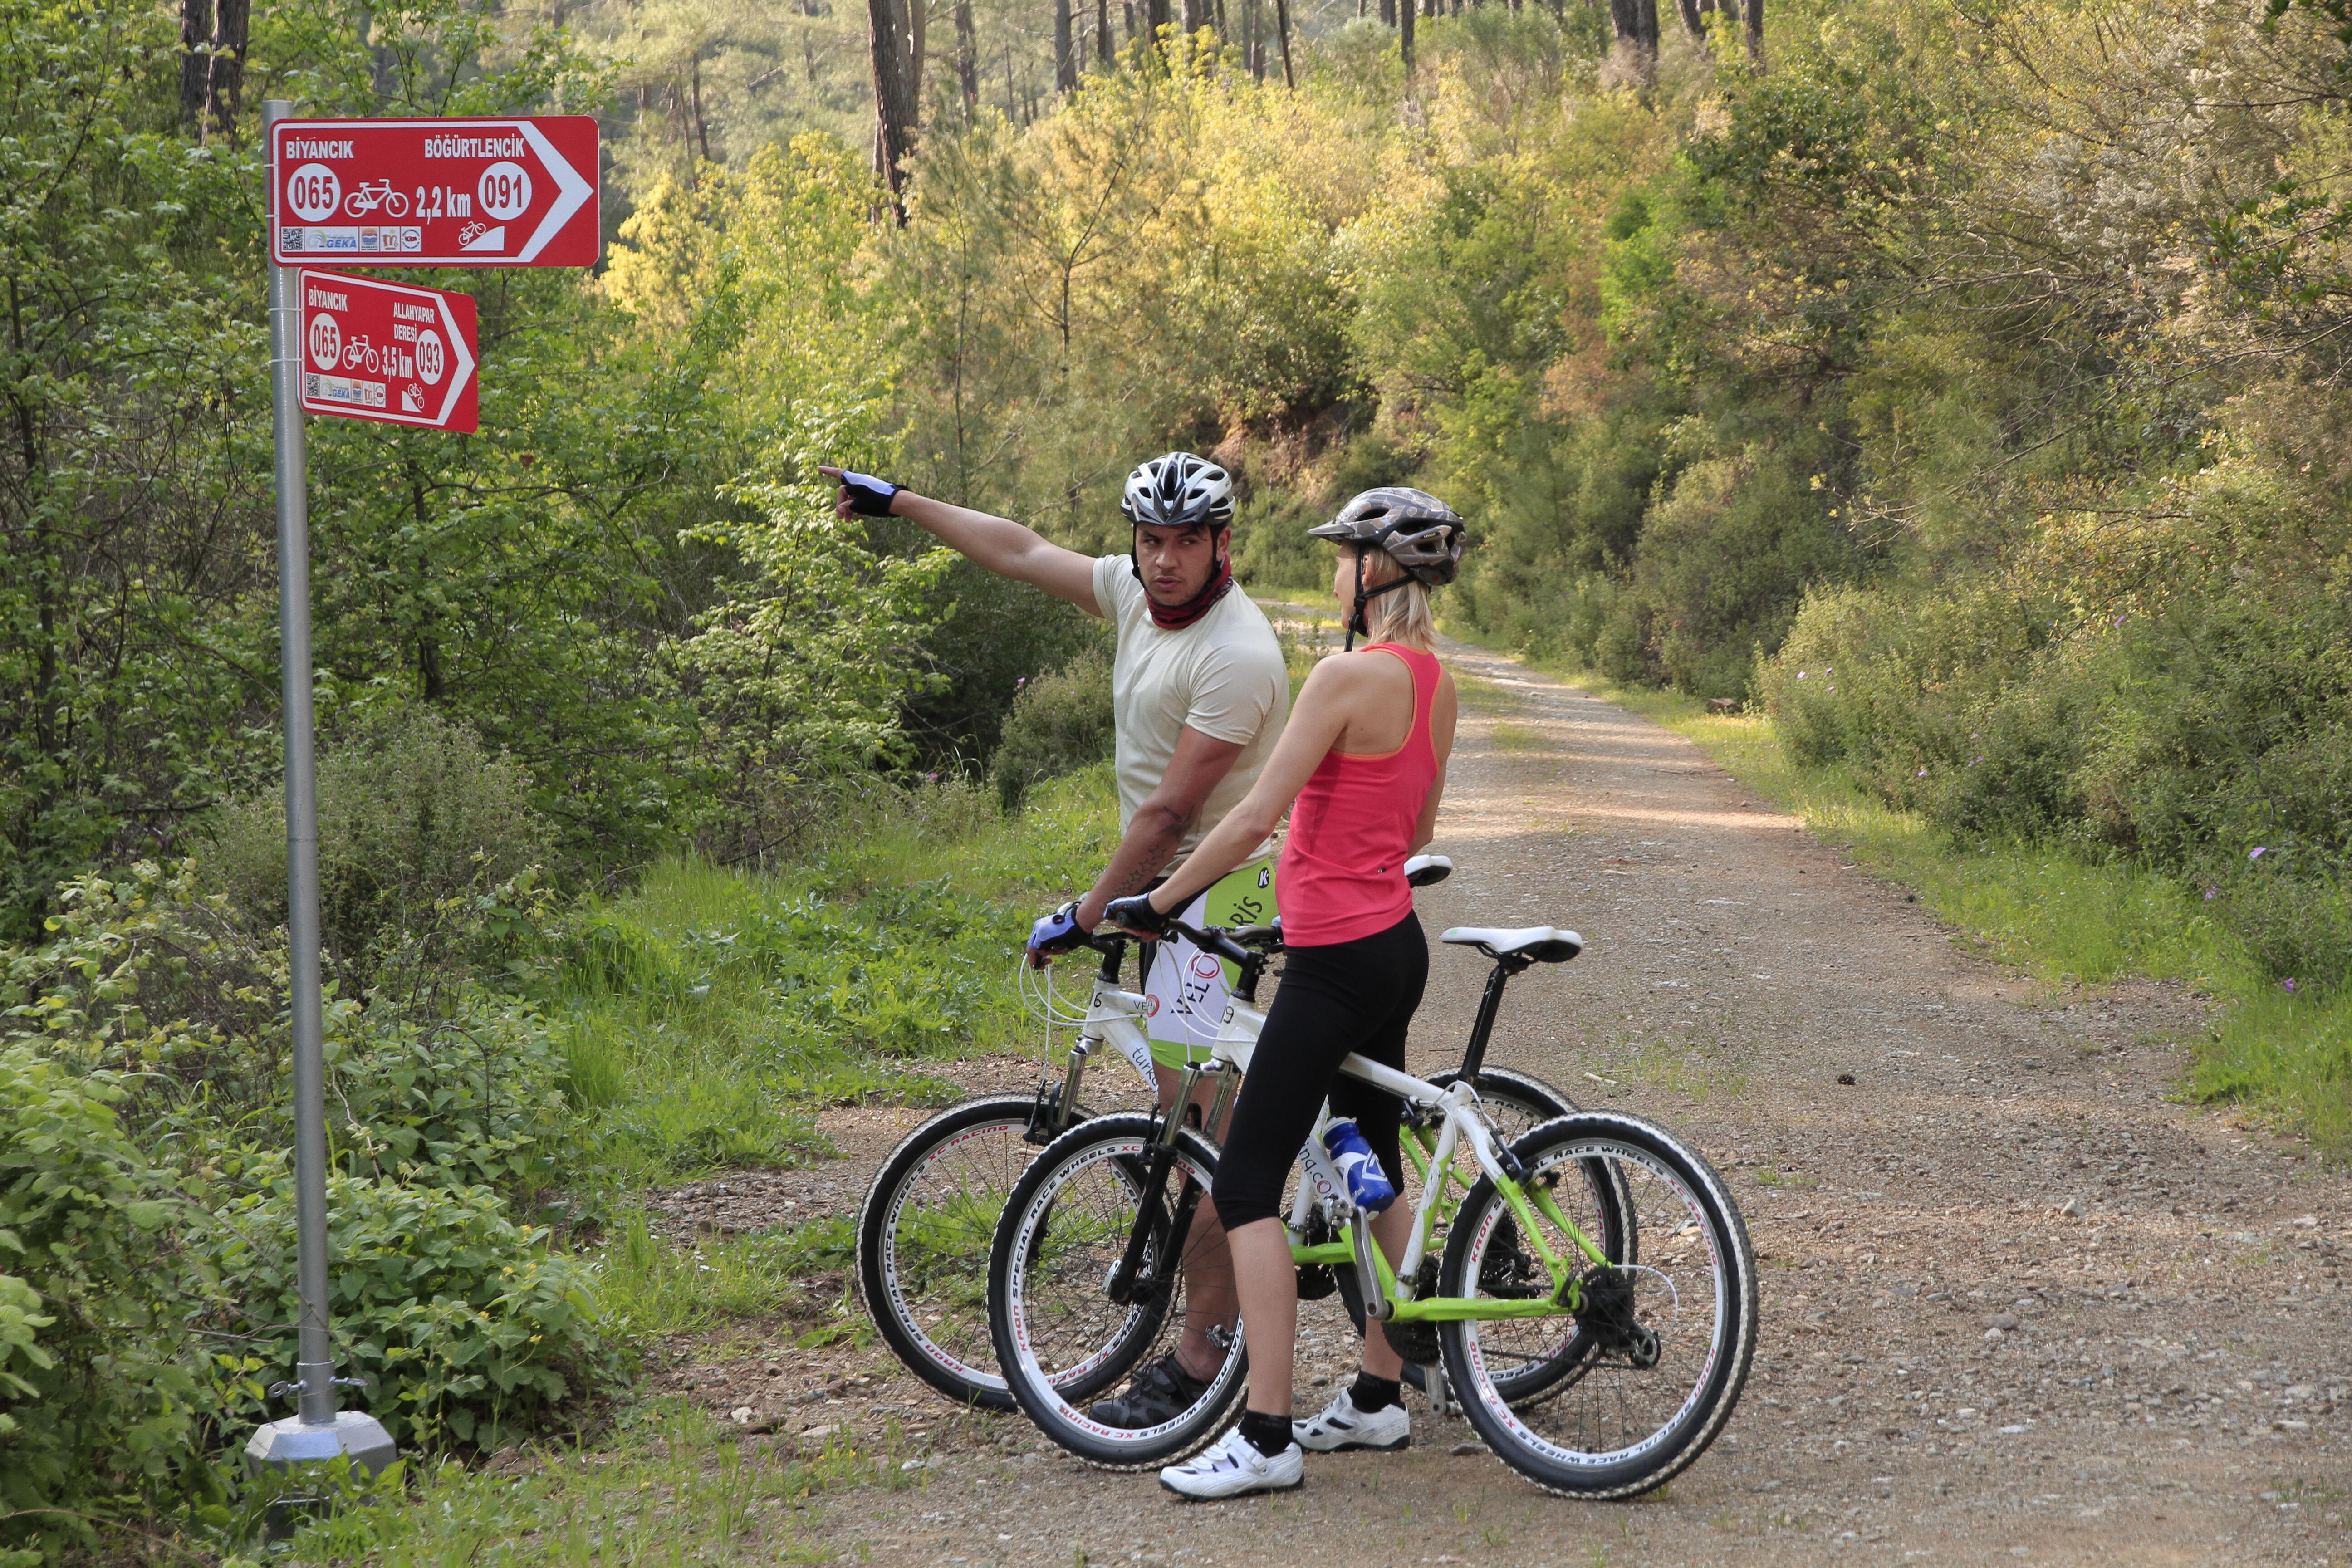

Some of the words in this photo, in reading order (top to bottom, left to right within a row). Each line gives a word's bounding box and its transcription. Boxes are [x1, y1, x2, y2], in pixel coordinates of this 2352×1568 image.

[286, 137, 353, 159] BİYANCIK
[425, 134, 525, 158] BÖĞÜRTLENCİK
[294, 176, 333, 209] 065
[416, 186, 442, 224] 2,2
[447, 187, 471, 217] km
[484, 174, 522, 208] 091
[327, 239, 357, 248] GEKA
[308, 285, 348, 312] BİYANCIK
[393, 302, 435, 324] ALLAHYAPAR
[313, 323, 337, 359] 065
[394, 323, 416, 343] DERESİ
[382, 345, 397, 382] 3,5
[399, 348, 412, 378] km
[419, 340, 440, 375] 093
[333, 389, 350, 399] GEKA
[950, 1125, 1009, 1146] RACING
[928, 1146, 946, 1162] XC
[1554, 1146, 1595, 1157] RACE
[1601, 1146, 1665, 1176] WHEELS
[1669, 1178, 1686, 1196] XC
[890, 1163, 925, 1224] WHEELS
[1012, 1225, 1031, 1298] SPECIAL
[1030, 1180, 1056, 1220] RACE
[1058, 1146, 1116, 1179] WHEELS
[885, 1230, 894, 1273] RACE
[889, 1279, 923, 1342] SPECIAL
[1200, 1366, 1228, 1405] RACE
[1139, 1405, 1197, 1439] WHEELS
[1497, 1410, 1515, 1429] XC
[1635, 1402, 1691, 1451] SPECIAL
[1518, 1431, 1581, 1464] WHEELS
[1587, 1452, 1629, 1464] RACE
